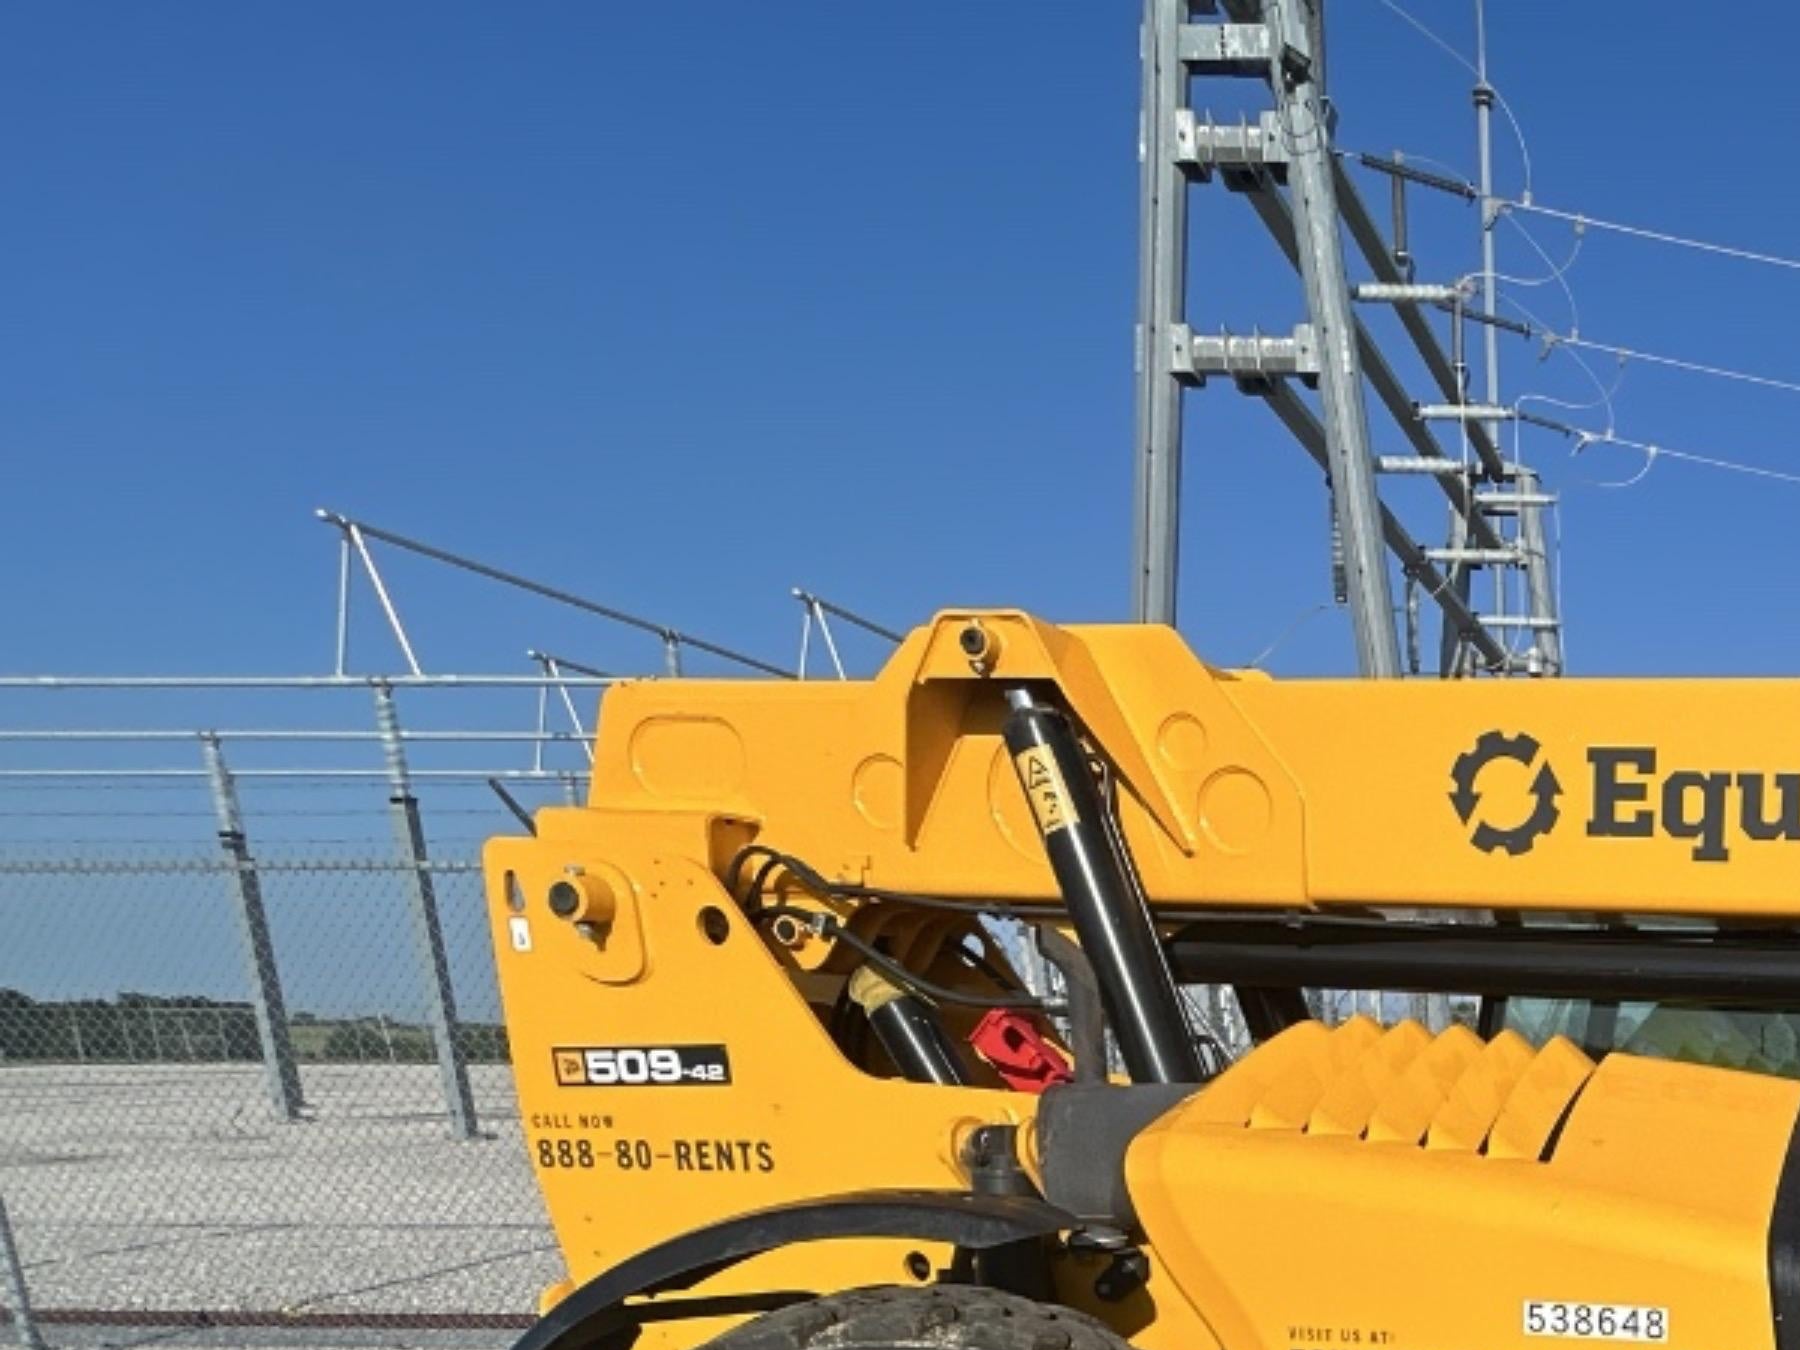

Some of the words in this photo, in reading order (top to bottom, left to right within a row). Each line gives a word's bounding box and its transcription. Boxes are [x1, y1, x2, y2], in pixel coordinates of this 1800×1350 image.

[584, 1049, 726, 1083] 509-42
[531, 1112, 573, 1129] CALL
[578, 1114, 614, 1129] NOW
[536, 1138, 775, 1173] 888-80-RENTS
[1288, 1326, 1331, 1343] VISIT
[1340, 1329, 1361, 1344] US
[1528, 1303, 1664, 1340] 538648
